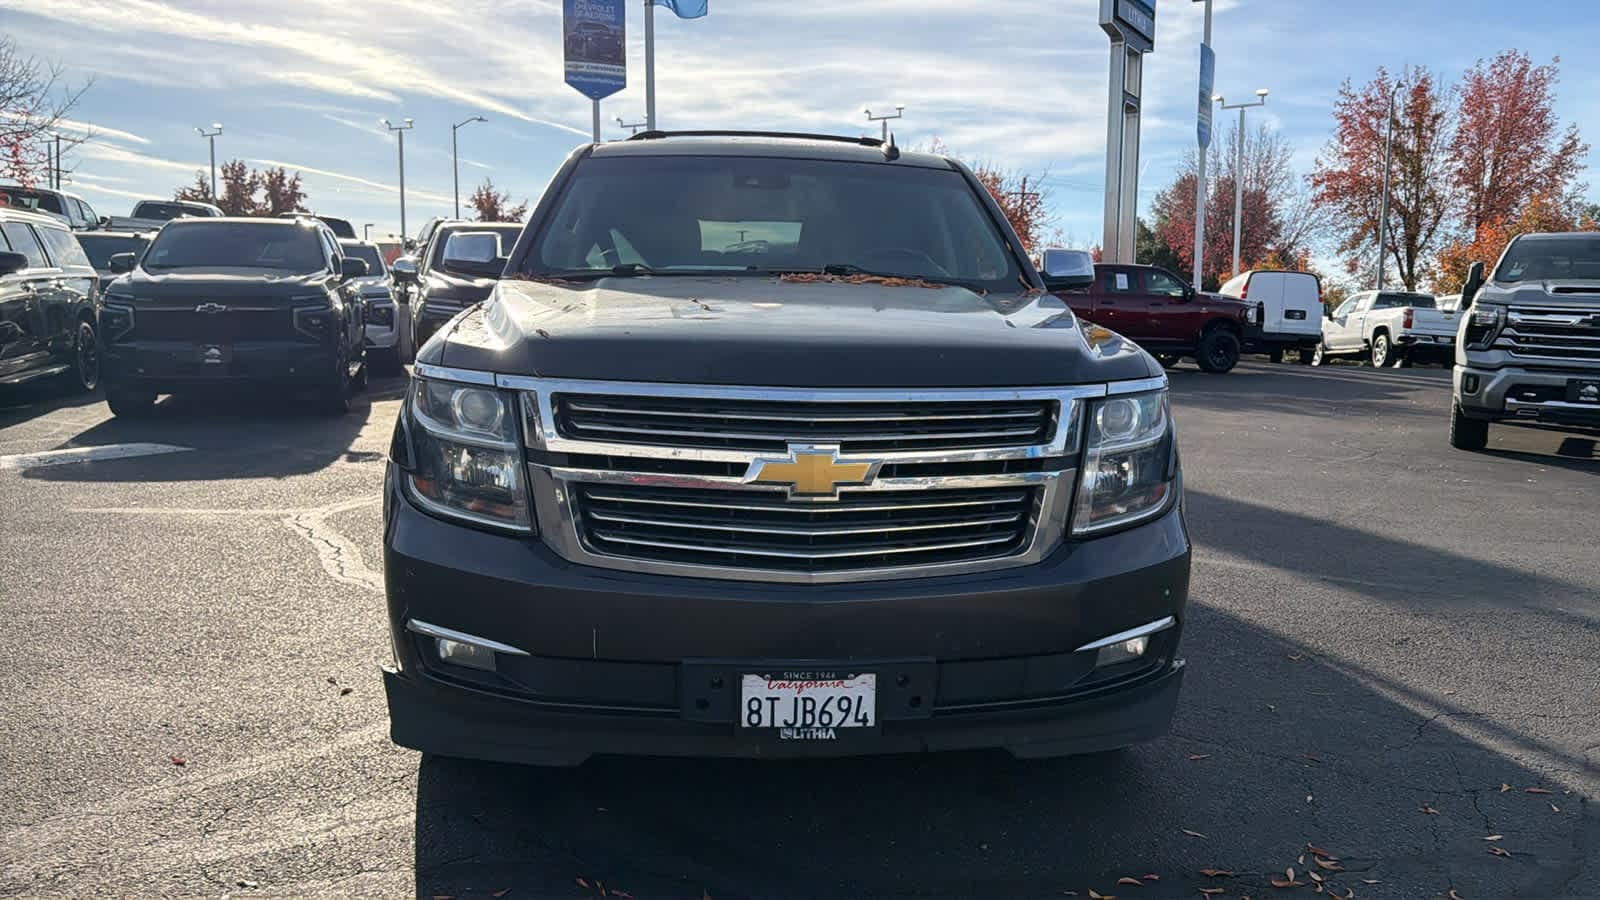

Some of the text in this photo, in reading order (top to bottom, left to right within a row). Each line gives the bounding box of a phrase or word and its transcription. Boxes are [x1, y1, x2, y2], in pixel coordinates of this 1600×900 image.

[783, 671, 813, 680] SINCE
[767, 679, 854, 695] California
[746, 695, 869, 727] 8TJB694
